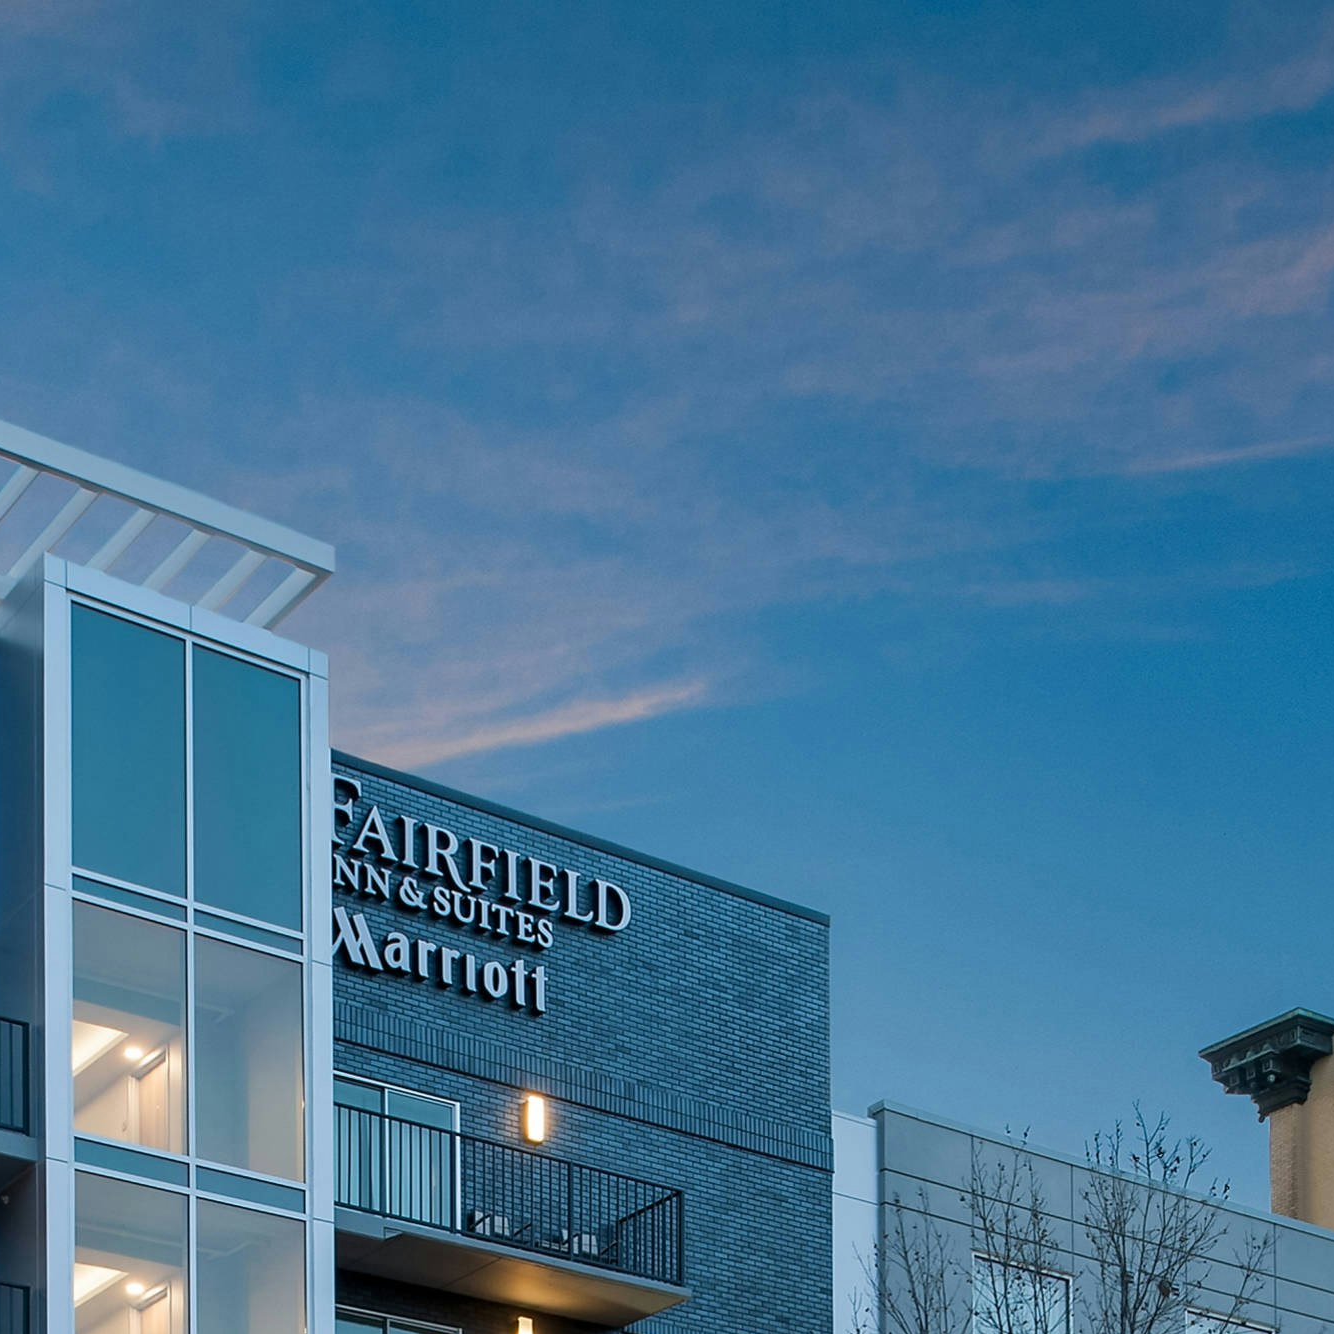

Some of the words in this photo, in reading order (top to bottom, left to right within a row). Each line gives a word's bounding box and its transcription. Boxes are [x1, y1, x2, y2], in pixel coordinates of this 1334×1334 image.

[331, 775, 632, 933] FAIRFIELD
[333, 854, 391, 901] NN
[398, 876, 428, 910] &
[432, 885, 554, 949] SUITES
[331, 905, 549, 1013] Marriott
